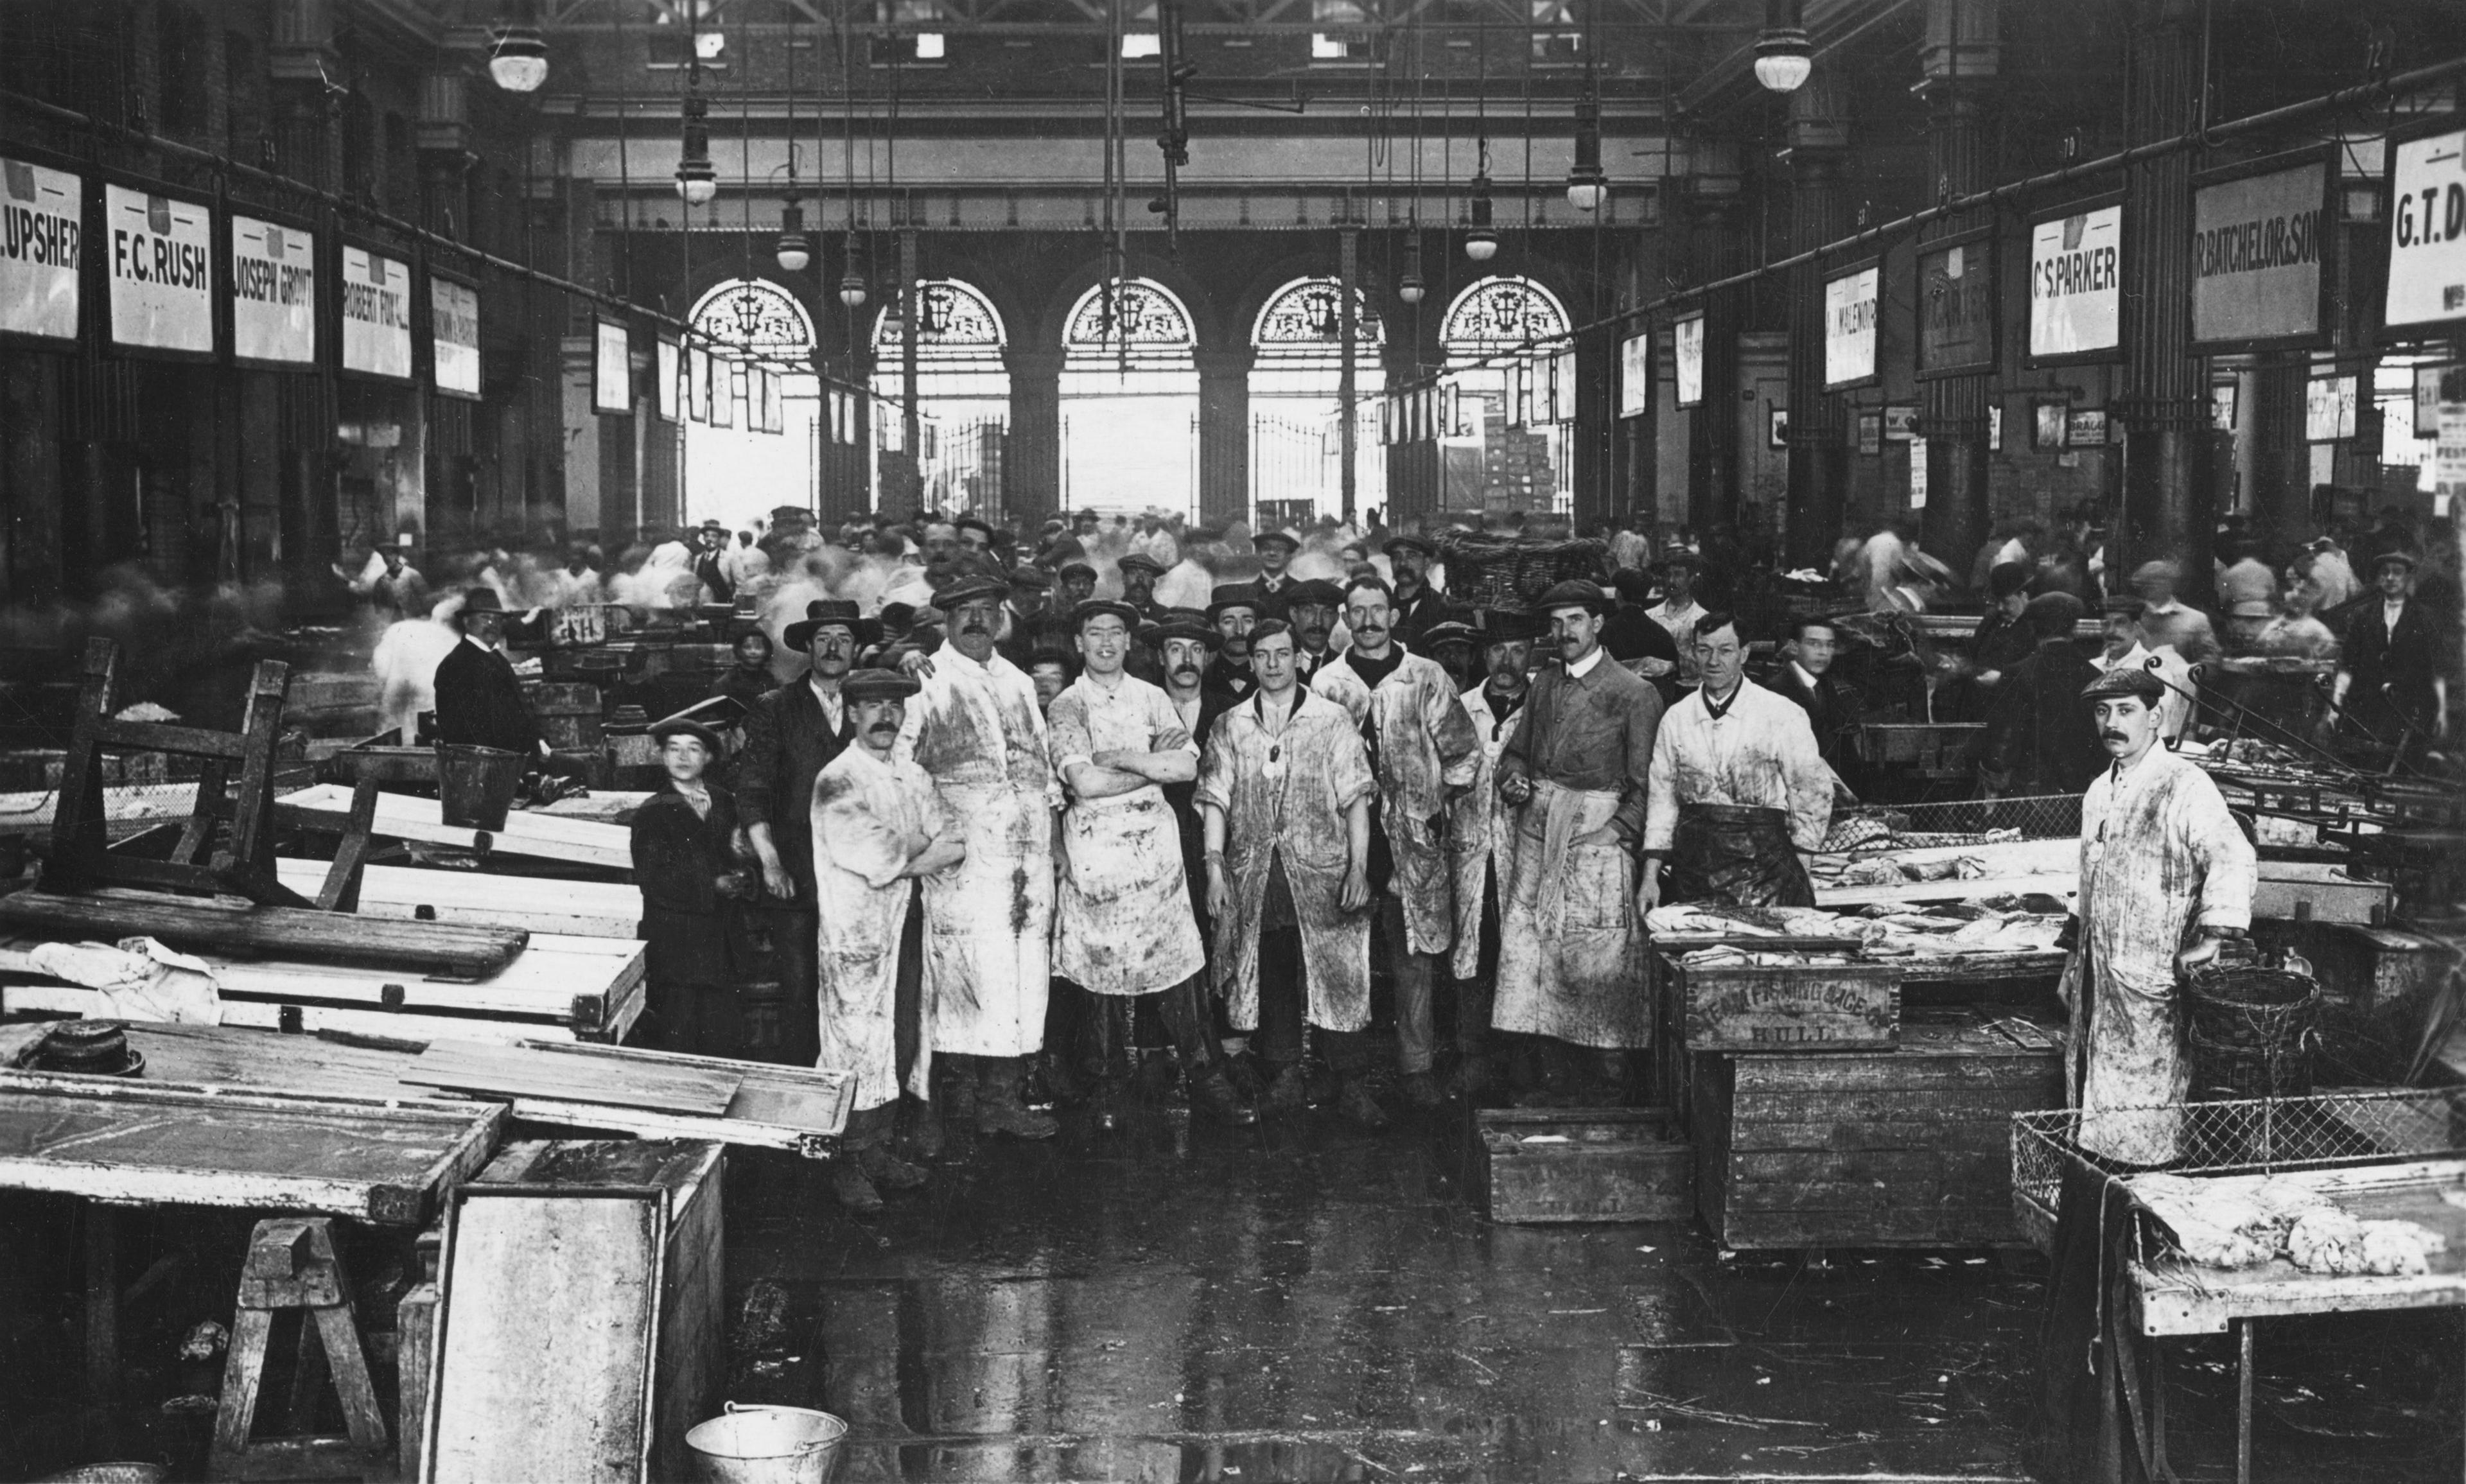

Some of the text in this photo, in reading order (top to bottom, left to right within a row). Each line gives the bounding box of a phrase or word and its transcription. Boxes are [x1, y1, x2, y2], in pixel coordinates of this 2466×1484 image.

[2396, 182, 2466, 249] G.T.D
[115, 229, 206, 290] F.C.RUSH
[233, 256, 277, 303] JOSEPH
[1751, 1026, 1833, 1043] HULL
